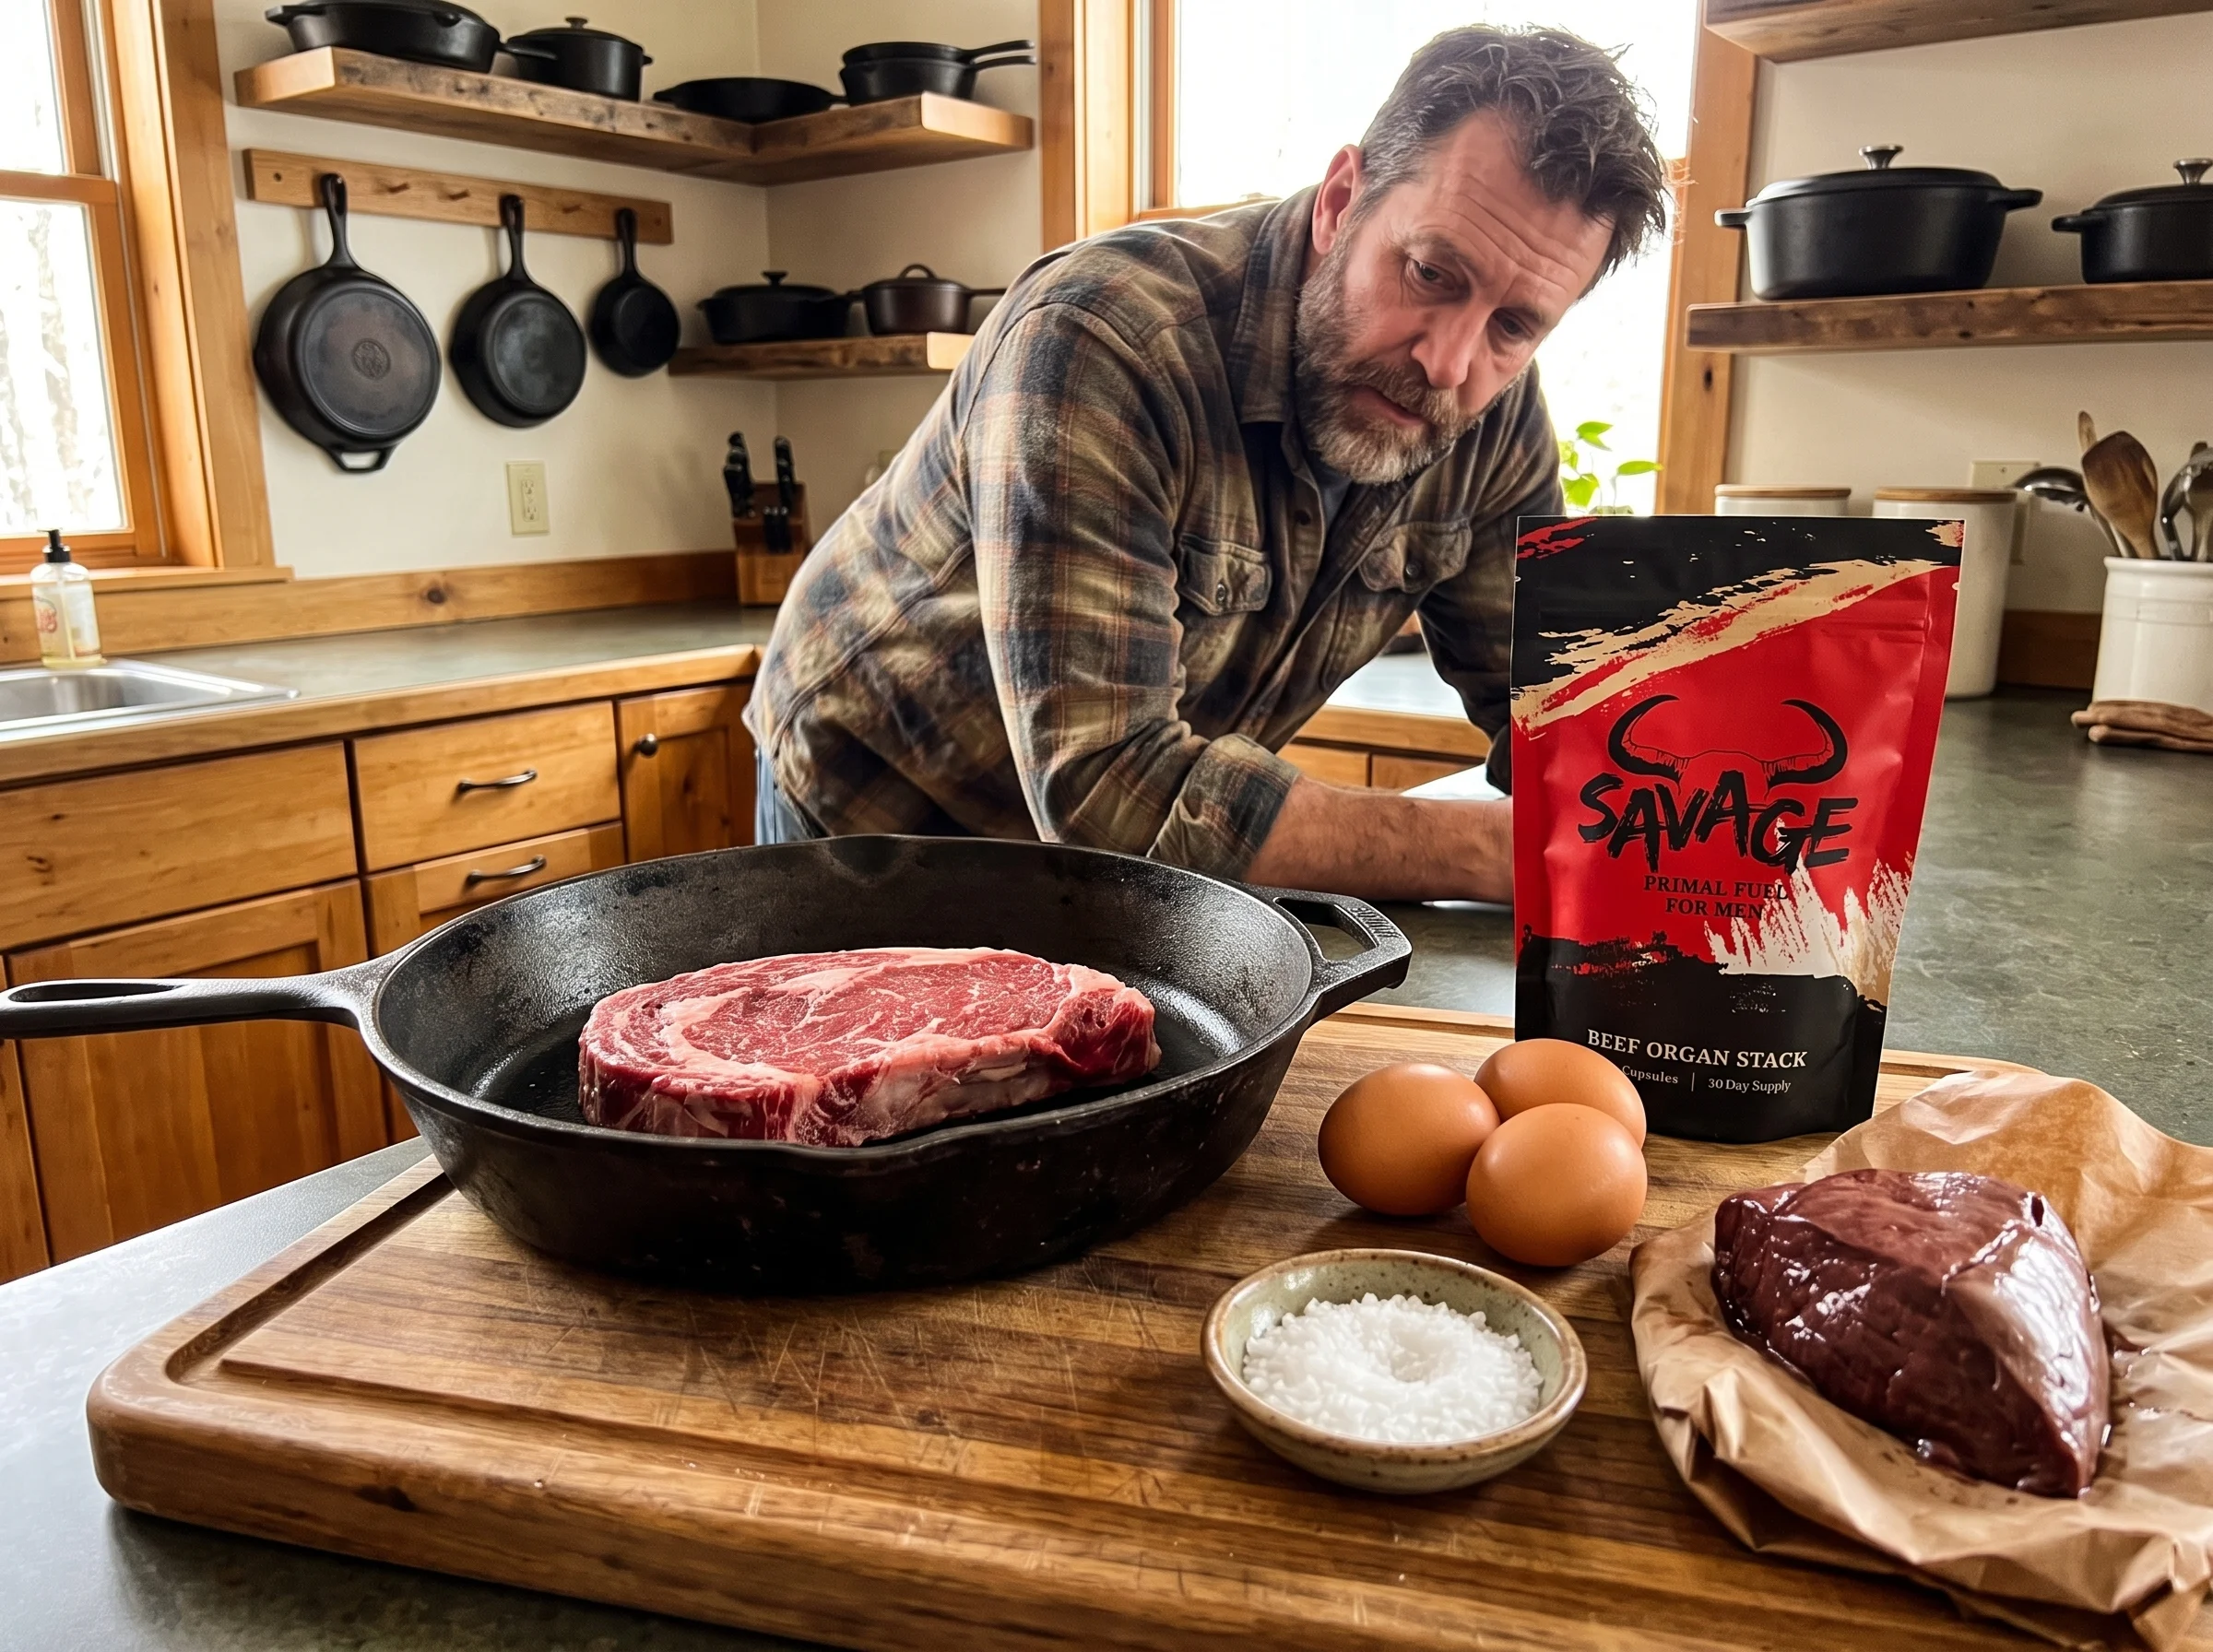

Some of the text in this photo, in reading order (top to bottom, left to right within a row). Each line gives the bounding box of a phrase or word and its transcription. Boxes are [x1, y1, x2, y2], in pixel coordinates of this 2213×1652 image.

[1578, 770, 1858, 874] SAVAGE
[1644, 875, 1788, 899] PRIMAL FUEL
[1665, 898, 1764, 920] FOR MEN
[1588, 1029, 1807, 1068] BEEF ORGAN STACK
[1708, 1079, 1723, 1089] 30
[1725, 1080, 1750, 1093] Day
[1752, 1080, 1791, 1094] Supply
